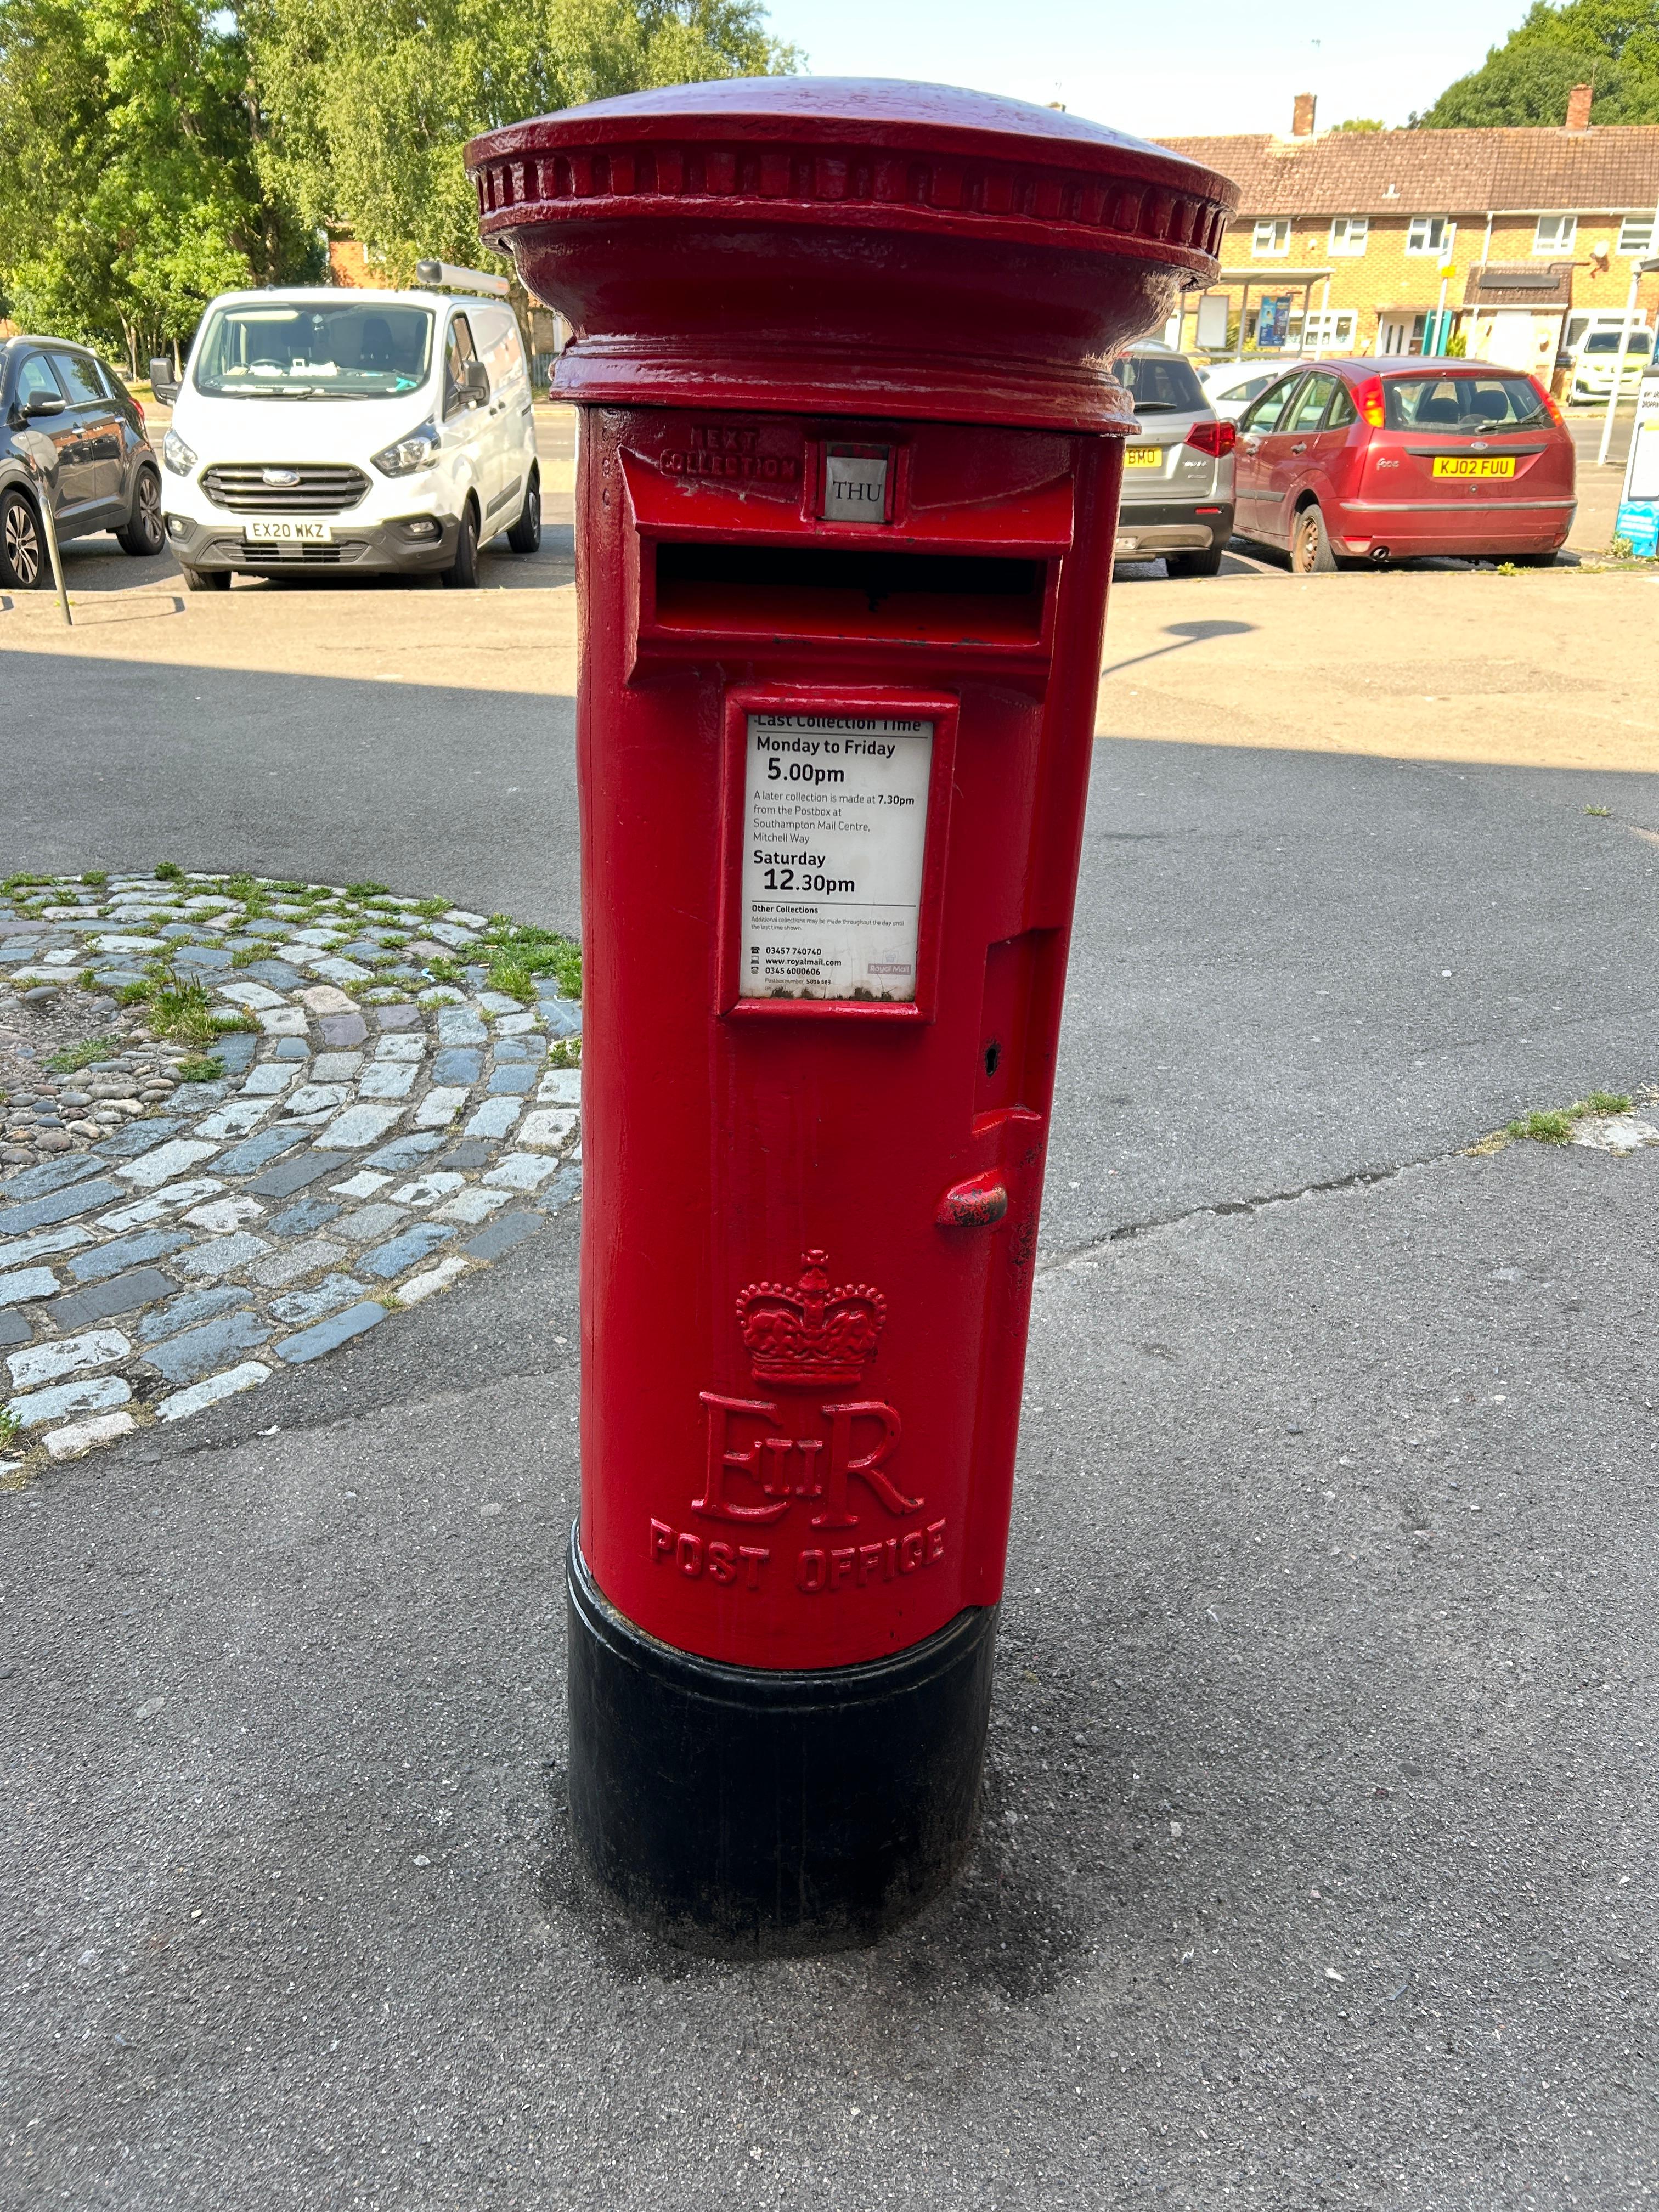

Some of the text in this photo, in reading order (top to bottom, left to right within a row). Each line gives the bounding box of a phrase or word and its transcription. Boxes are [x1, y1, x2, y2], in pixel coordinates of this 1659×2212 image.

[690, 426, 758, 451] NEXT
[659, 447, 799, 481] COLLECTION
[1128, 449, 1155, 464] BMO
[1440, 460, 1509, 474] KJ02 FUU
[832, 480, 882, 502] THU
[253, 523, 324, 538] EX20 WKZ
[758, 715, 792, 727] Last
[757, 736, 895, 758] Monday to Friday
[768, 757, 845, 786] 5.00pm
[754, 790, 915, 806] A later collection is made at 7.30pm
[754, 804, 842, 817] from the Postbox at
[753, 818, 871, 832] Southampton Mail Centre,
[753, 832, 810, 845] Mitchell Way
[753, 850, 826, 868] Saturday
[764, 868, 856, 895] 12.30pm
[752, 905, 819, 914] Other Collections
[792, 947, 822, 956] 740740
[765, 958, 842, 966] www.royalmail.com
[870, 964, 910, 973] Royal Mail
[786, 967, 821, 975] 6000606
[650, 1516, 947, 1592] POST OFFICE
